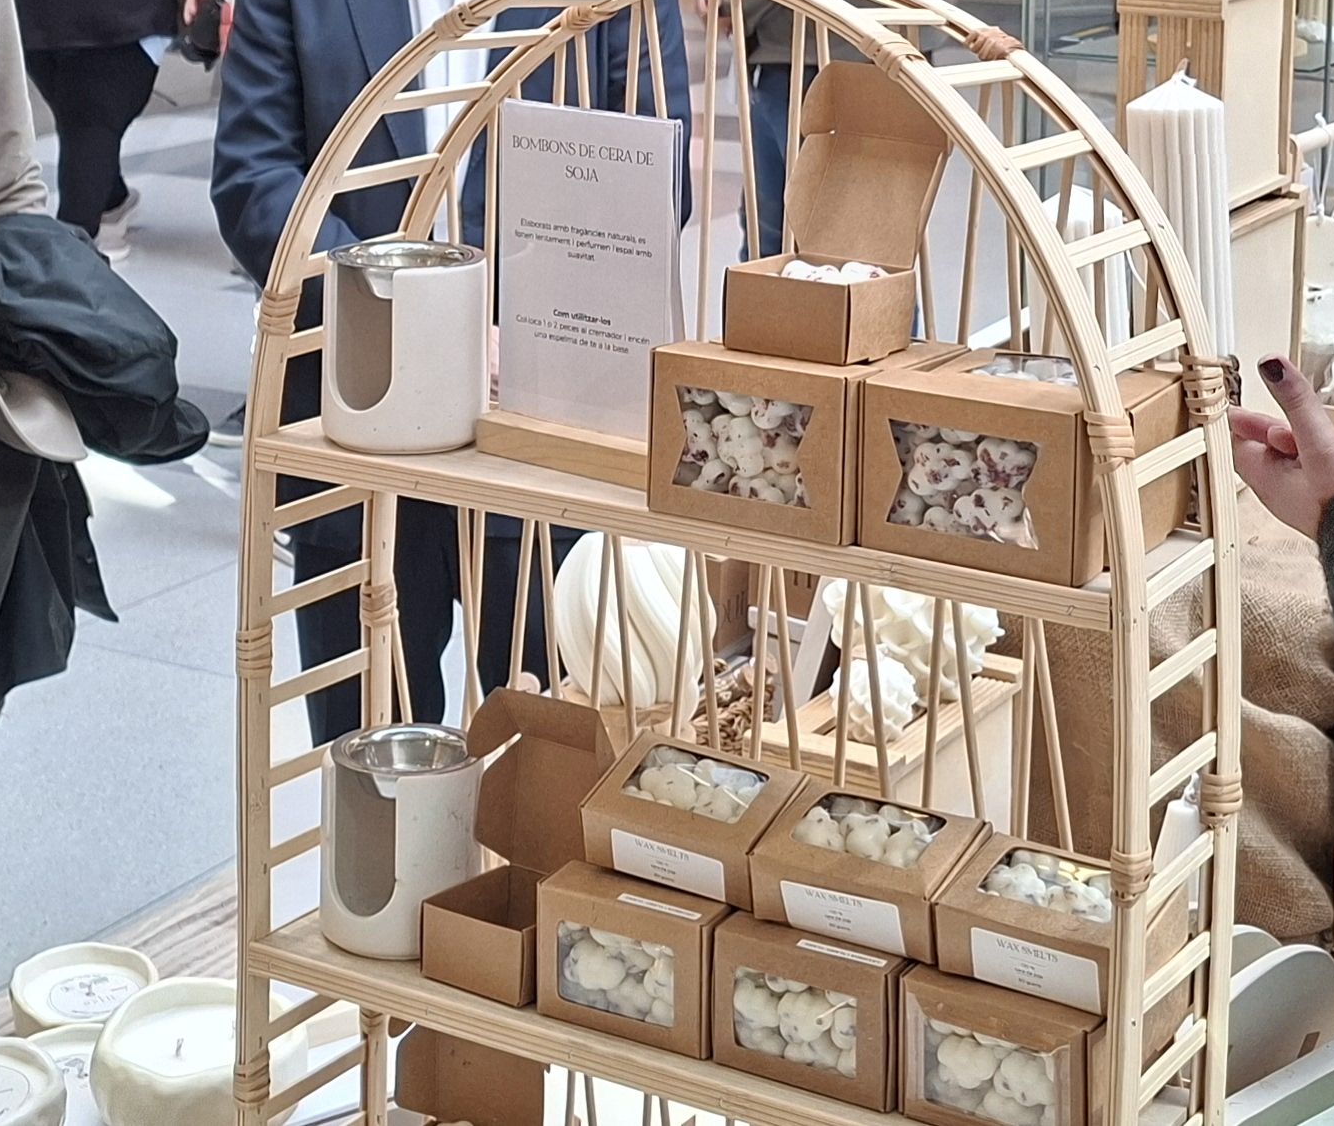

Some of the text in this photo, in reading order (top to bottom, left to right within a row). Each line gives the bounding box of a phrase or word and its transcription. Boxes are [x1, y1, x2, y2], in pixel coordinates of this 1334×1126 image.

[512, 134, 654, 166] BOMBONS DE CERA DE
[565, 164, 599, 182] SOJA
[553, 224, 569, 233] amb
[553, 308, 570, 319] Com
[634, 837, 655, 851] WAX
[995, 937, 1020, 953] WAX
